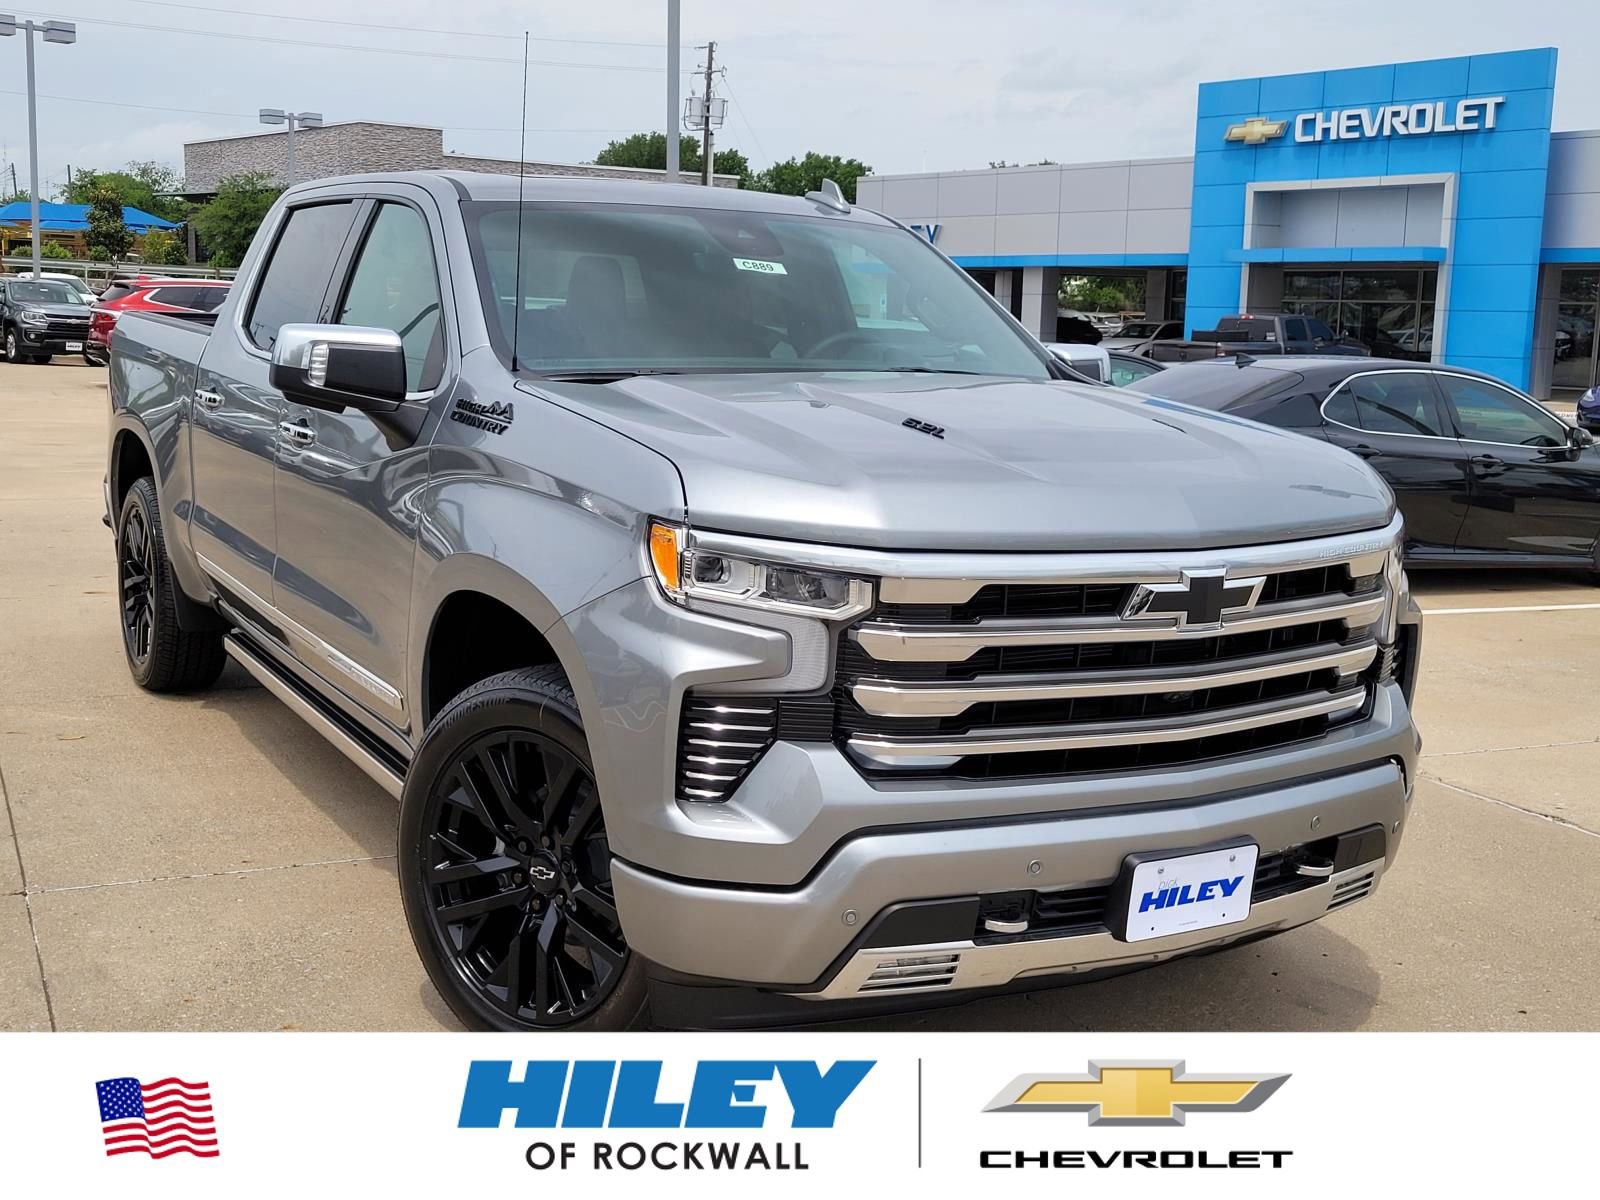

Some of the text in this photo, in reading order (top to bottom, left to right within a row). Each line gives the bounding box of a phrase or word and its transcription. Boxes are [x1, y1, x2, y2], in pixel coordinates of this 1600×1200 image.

[1294, 96, 1505, 143] CHEVROLET
[742, 261, 774, 271] C889
[450, 410, 509, 435] COUNTRY
[1139, 876, 1245, 913] HILEY
